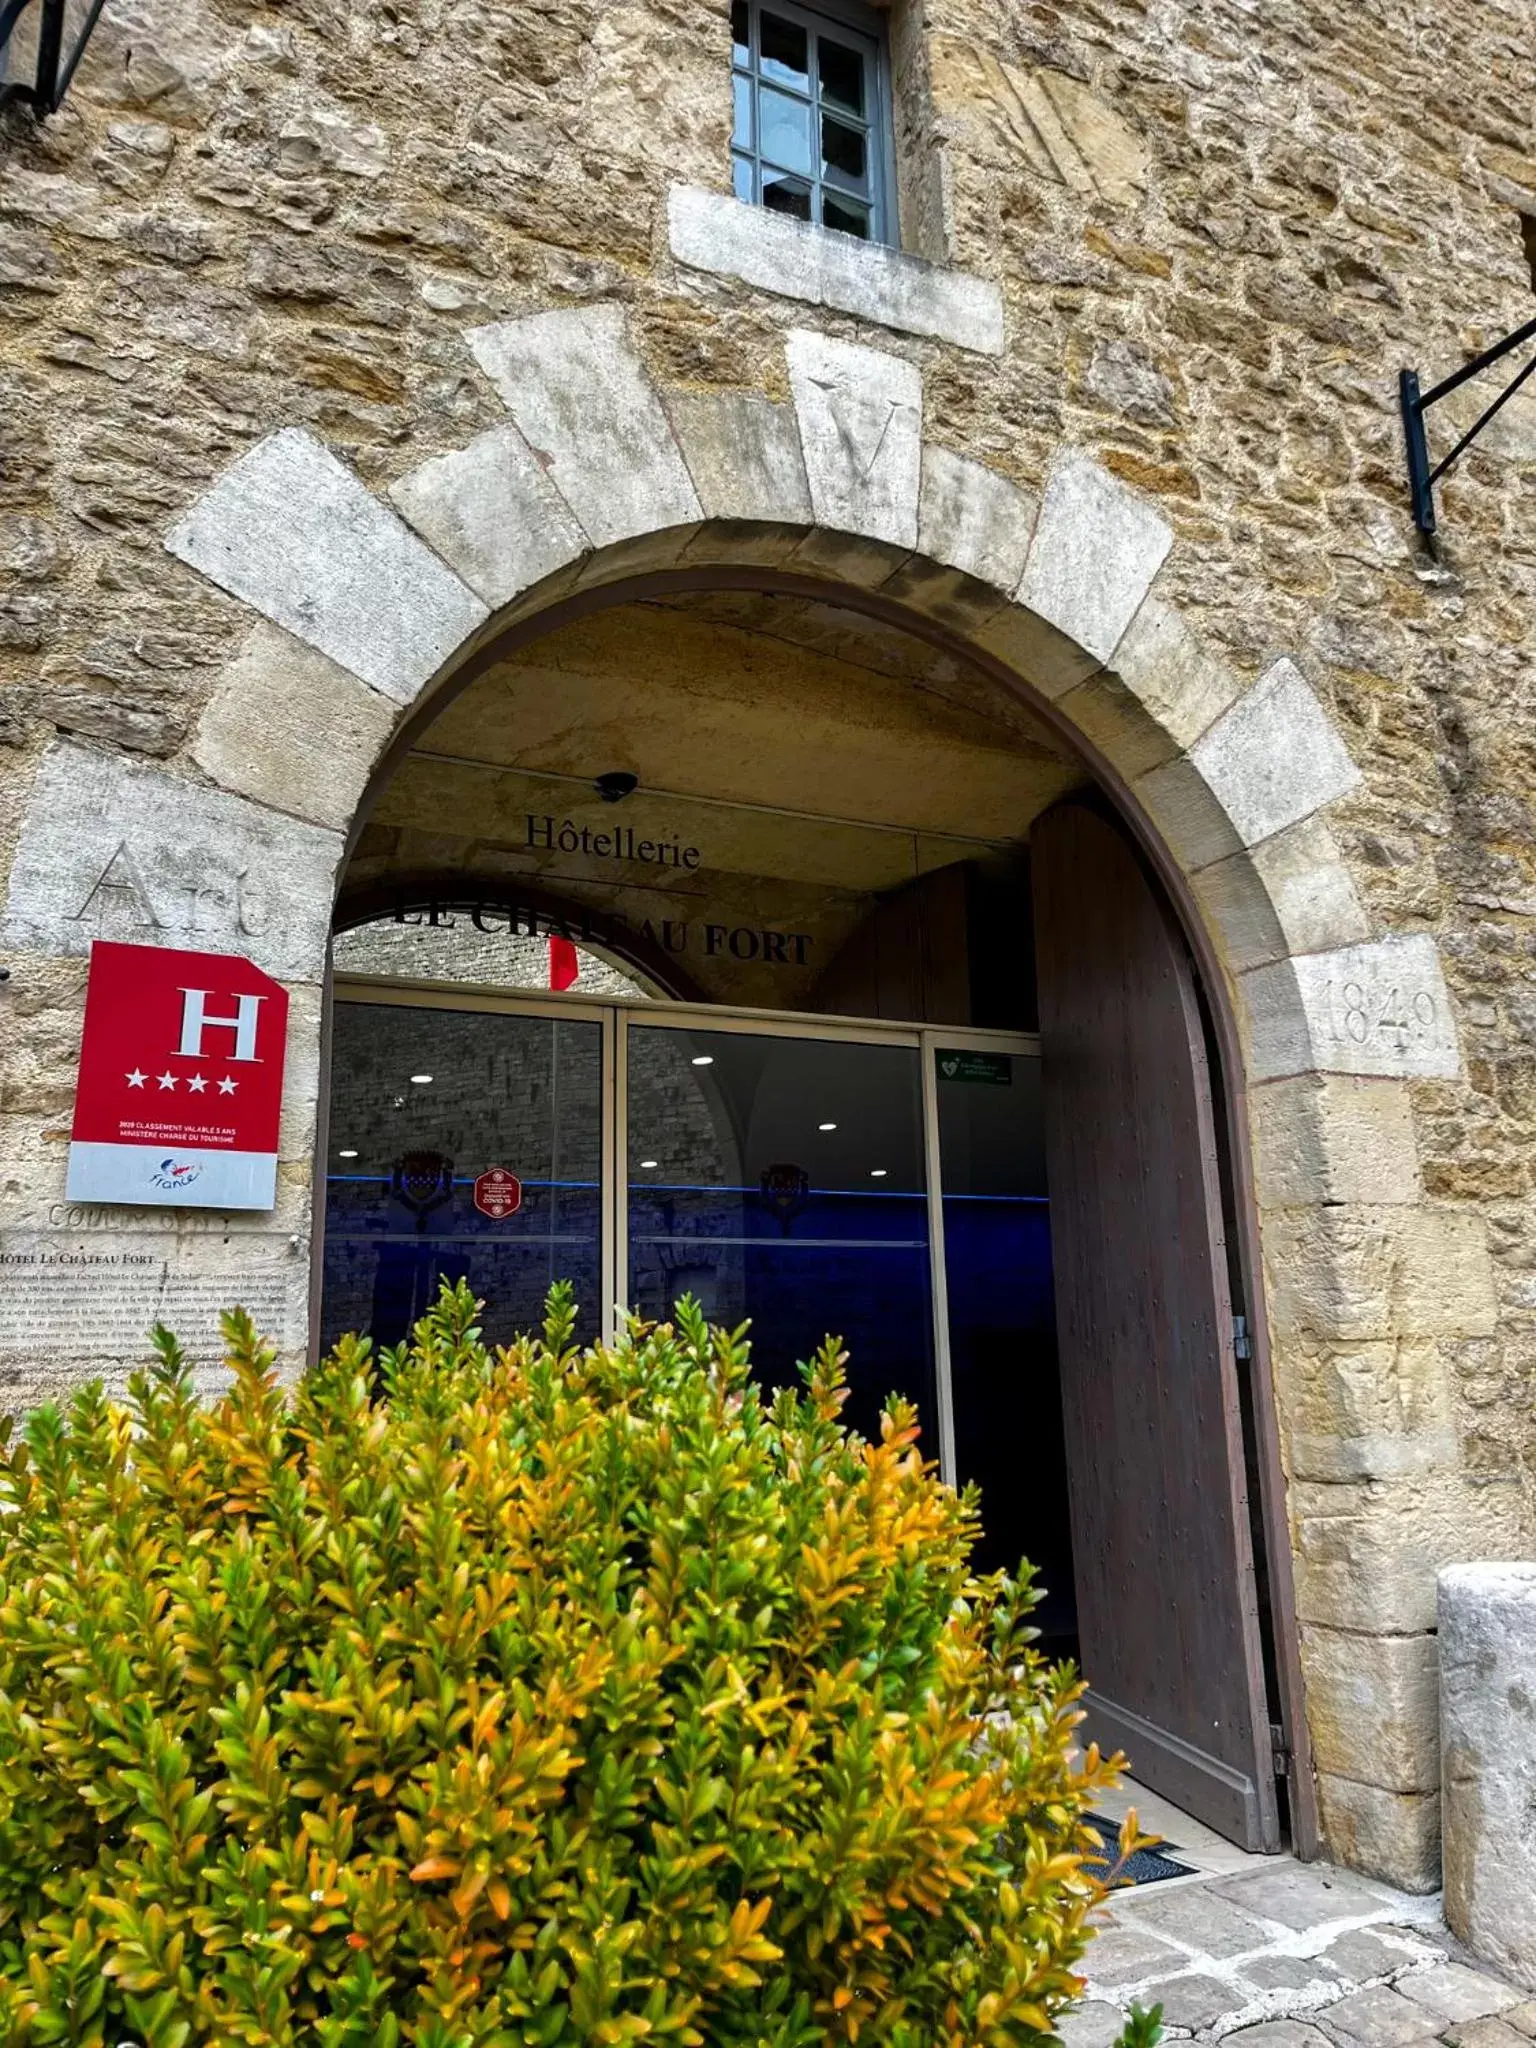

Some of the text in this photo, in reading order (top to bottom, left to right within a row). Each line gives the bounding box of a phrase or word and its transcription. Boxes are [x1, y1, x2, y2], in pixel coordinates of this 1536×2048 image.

[525, 813, 701, 870] Hôtellerie
[395, 892, 455, 929] LE
[702, 923, 814, 967] FORT
[169, 986, 269, 1063] H
[136, 1121, 182, 1132] CLASSEMENT
[184, 1125, 214, 1134] VALABLE
[222, 1128, 236, 1136] ANS
[200, 1134, 234, 1143] TOURISME
[149, 1172, 200, 1190] France
